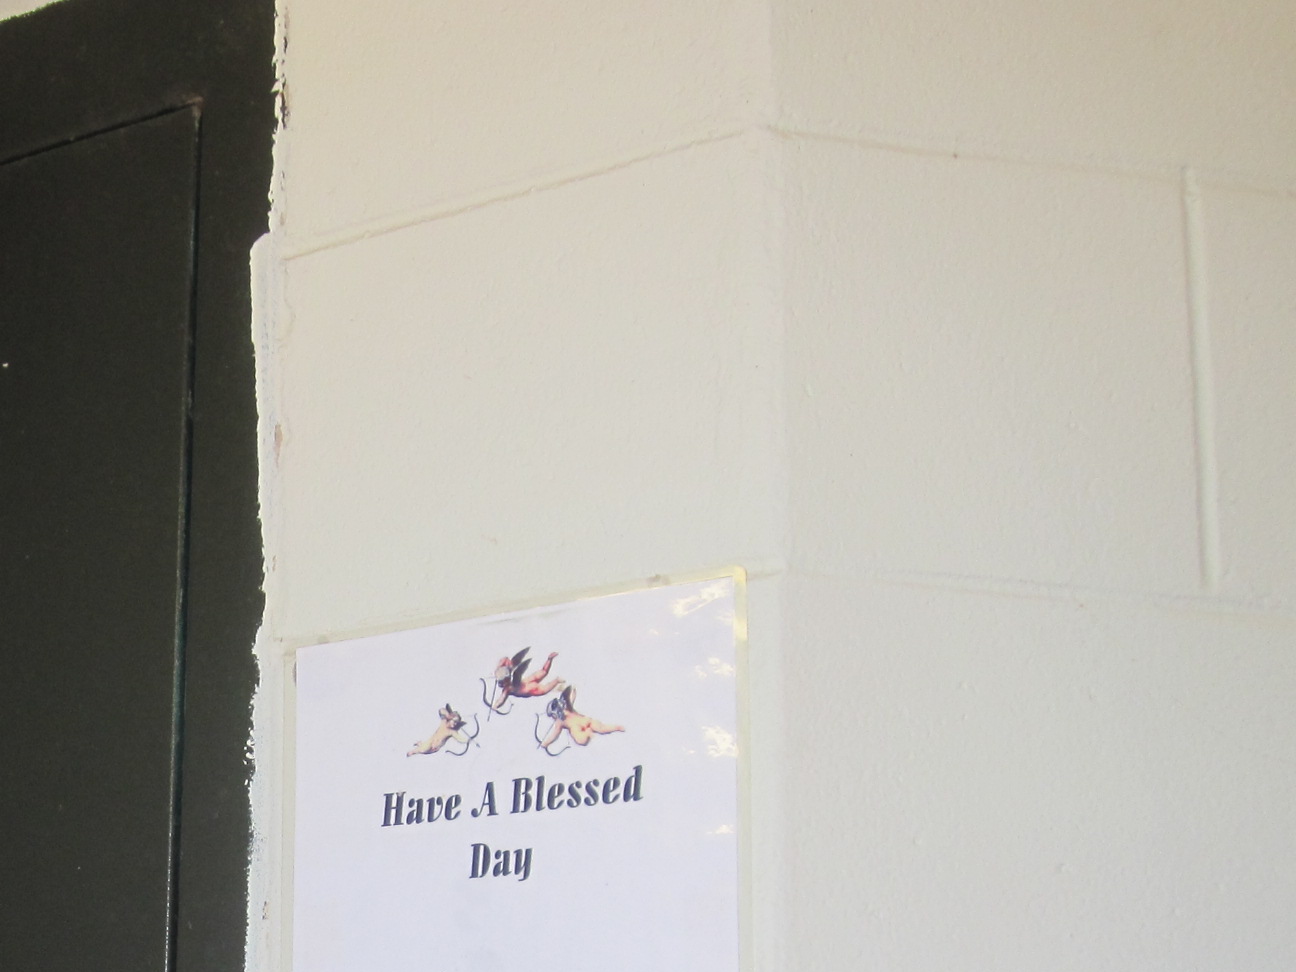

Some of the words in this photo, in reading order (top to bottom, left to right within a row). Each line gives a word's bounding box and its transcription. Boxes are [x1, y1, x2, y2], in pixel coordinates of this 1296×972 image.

[381, 791, 461, 827] Have
[470, 781, 499, 818] A
[510, 765, 644, 815] Blessed
[469, 842, 533, 882] Day
